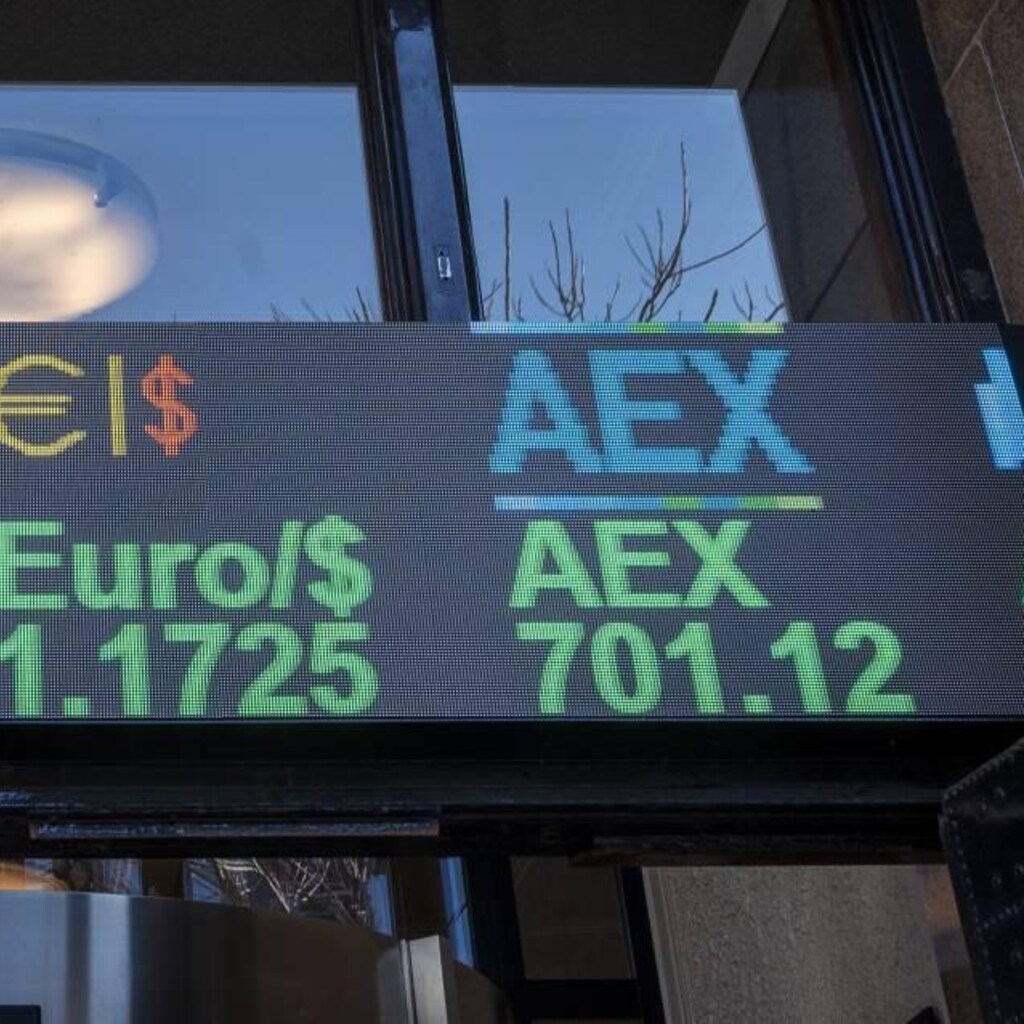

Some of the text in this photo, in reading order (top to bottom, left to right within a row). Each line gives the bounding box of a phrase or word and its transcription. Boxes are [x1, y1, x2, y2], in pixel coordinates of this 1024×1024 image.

[487, 348, 816, 475] AEX
[509, 519, 771, 611] AEX
[513, 620, 918, 716] 701.12
